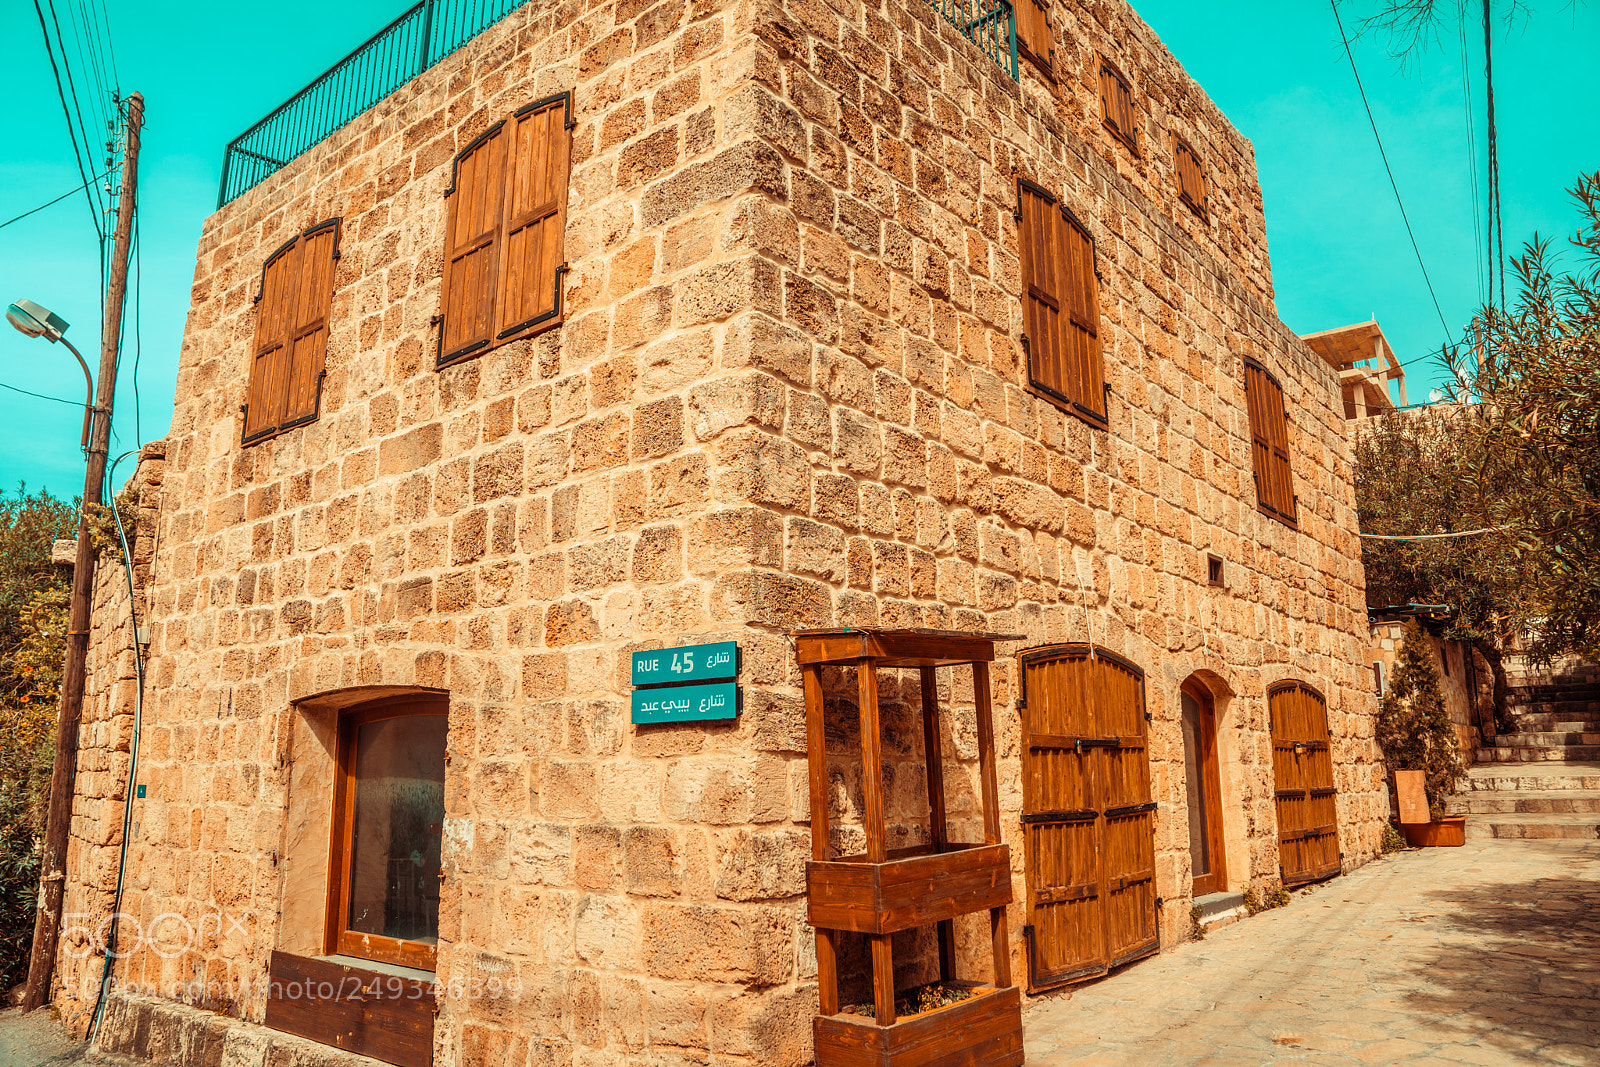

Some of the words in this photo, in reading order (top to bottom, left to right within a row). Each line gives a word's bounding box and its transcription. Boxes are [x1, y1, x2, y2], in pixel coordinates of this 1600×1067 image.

[637, 659, 659, 673] RUE
[670, 651, 694, 674] 45
[706, 651, 730, 668] شارع
[640, 701, 659, 715] عبد
[698, 694, 725, 712] شارع
